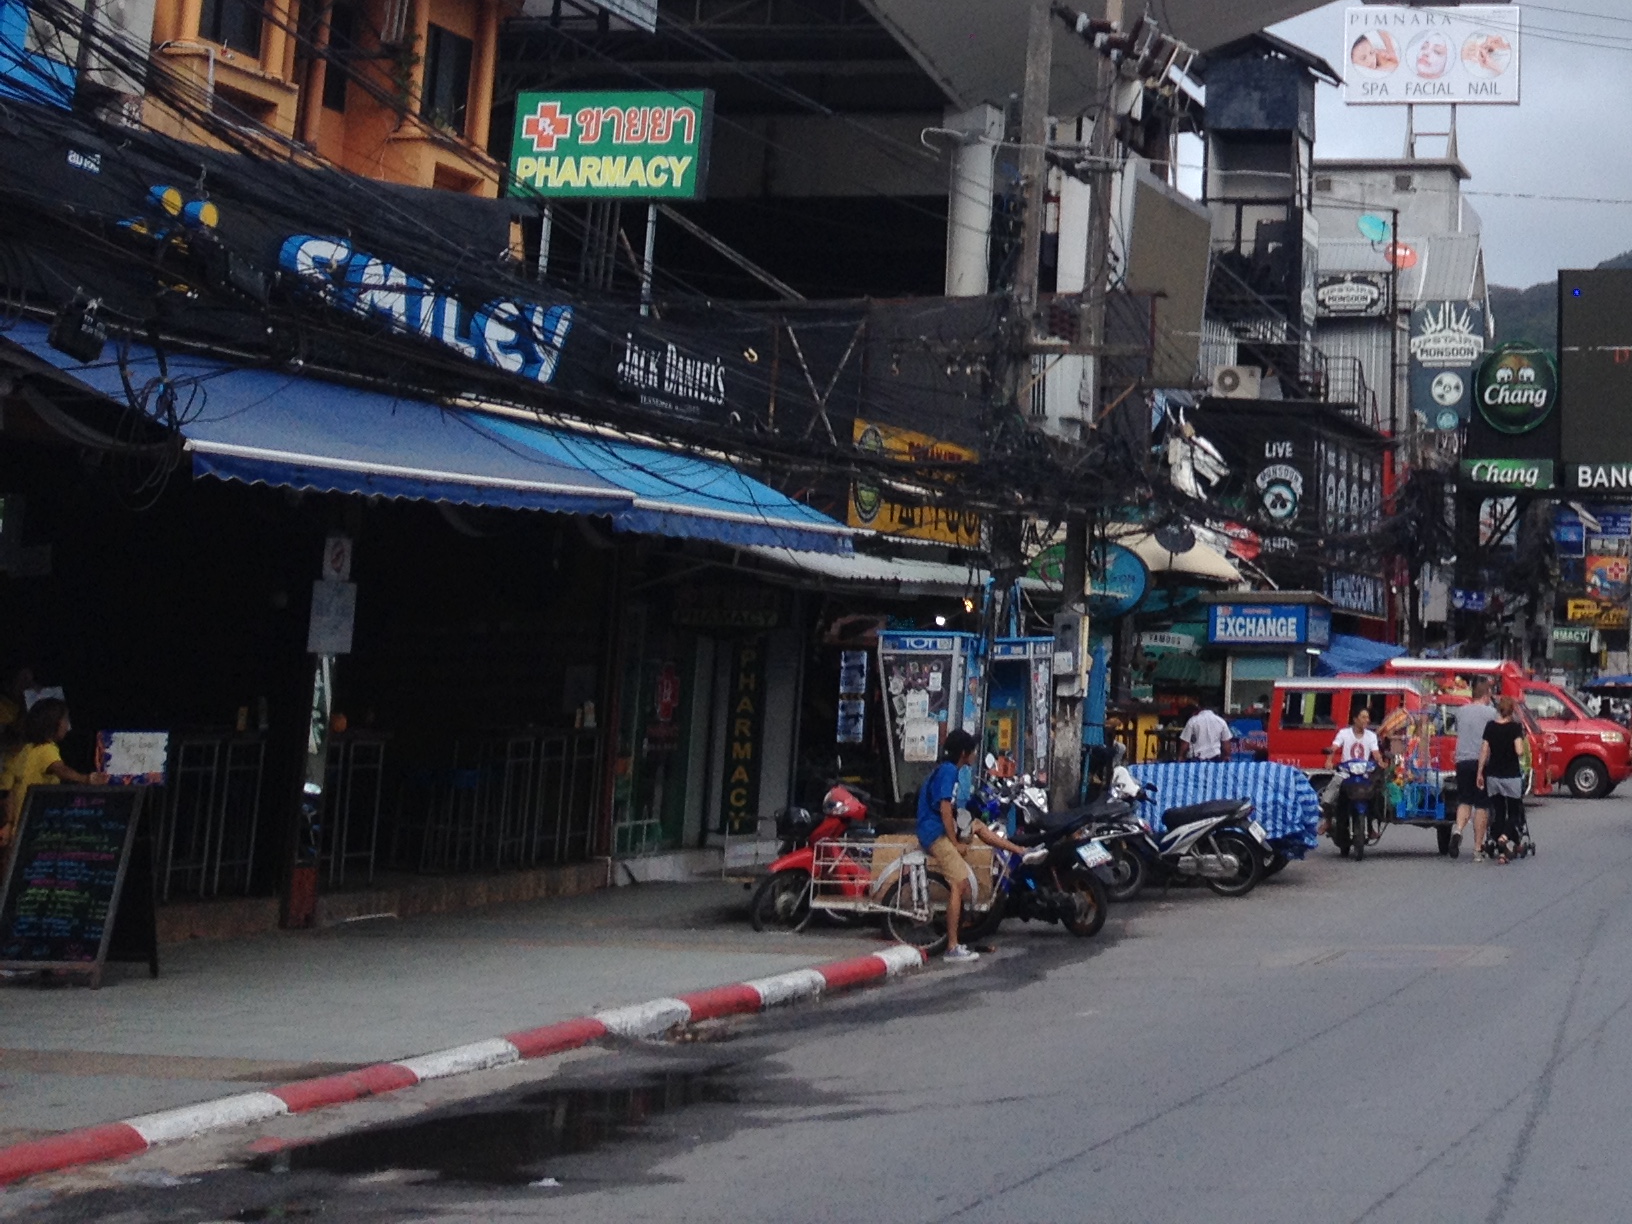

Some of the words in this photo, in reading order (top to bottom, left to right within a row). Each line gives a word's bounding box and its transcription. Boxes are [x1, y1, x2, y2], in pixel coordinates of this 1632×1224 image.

[1350, 14, 1453, 26] PIMNARA
[1362, 82, 1389, 96] SPA
[1405, 82, 1454, 96] FACIAL
[1468, 82, 1502, 95] NAIL
[576, 106, 696, 145] ขายยา
[515, 156, 693, 189] PHARMACY
[1327, 295, 1369, 303] MONSOON
[617, 332, 661, 389] JACK
[1420, 348, 1475, 358] MONSOON
[1484, 385, 1548, 408] Chang
[1265, 441, 1293, 458] LIVE
[1471, 460, 1539, 485] Chang
[1216, 616, 1298, 637] EXCHANGE
[1150, 634, 1182, 645] FAMOUS
[729, 648, 758, 832] PHARMACY
